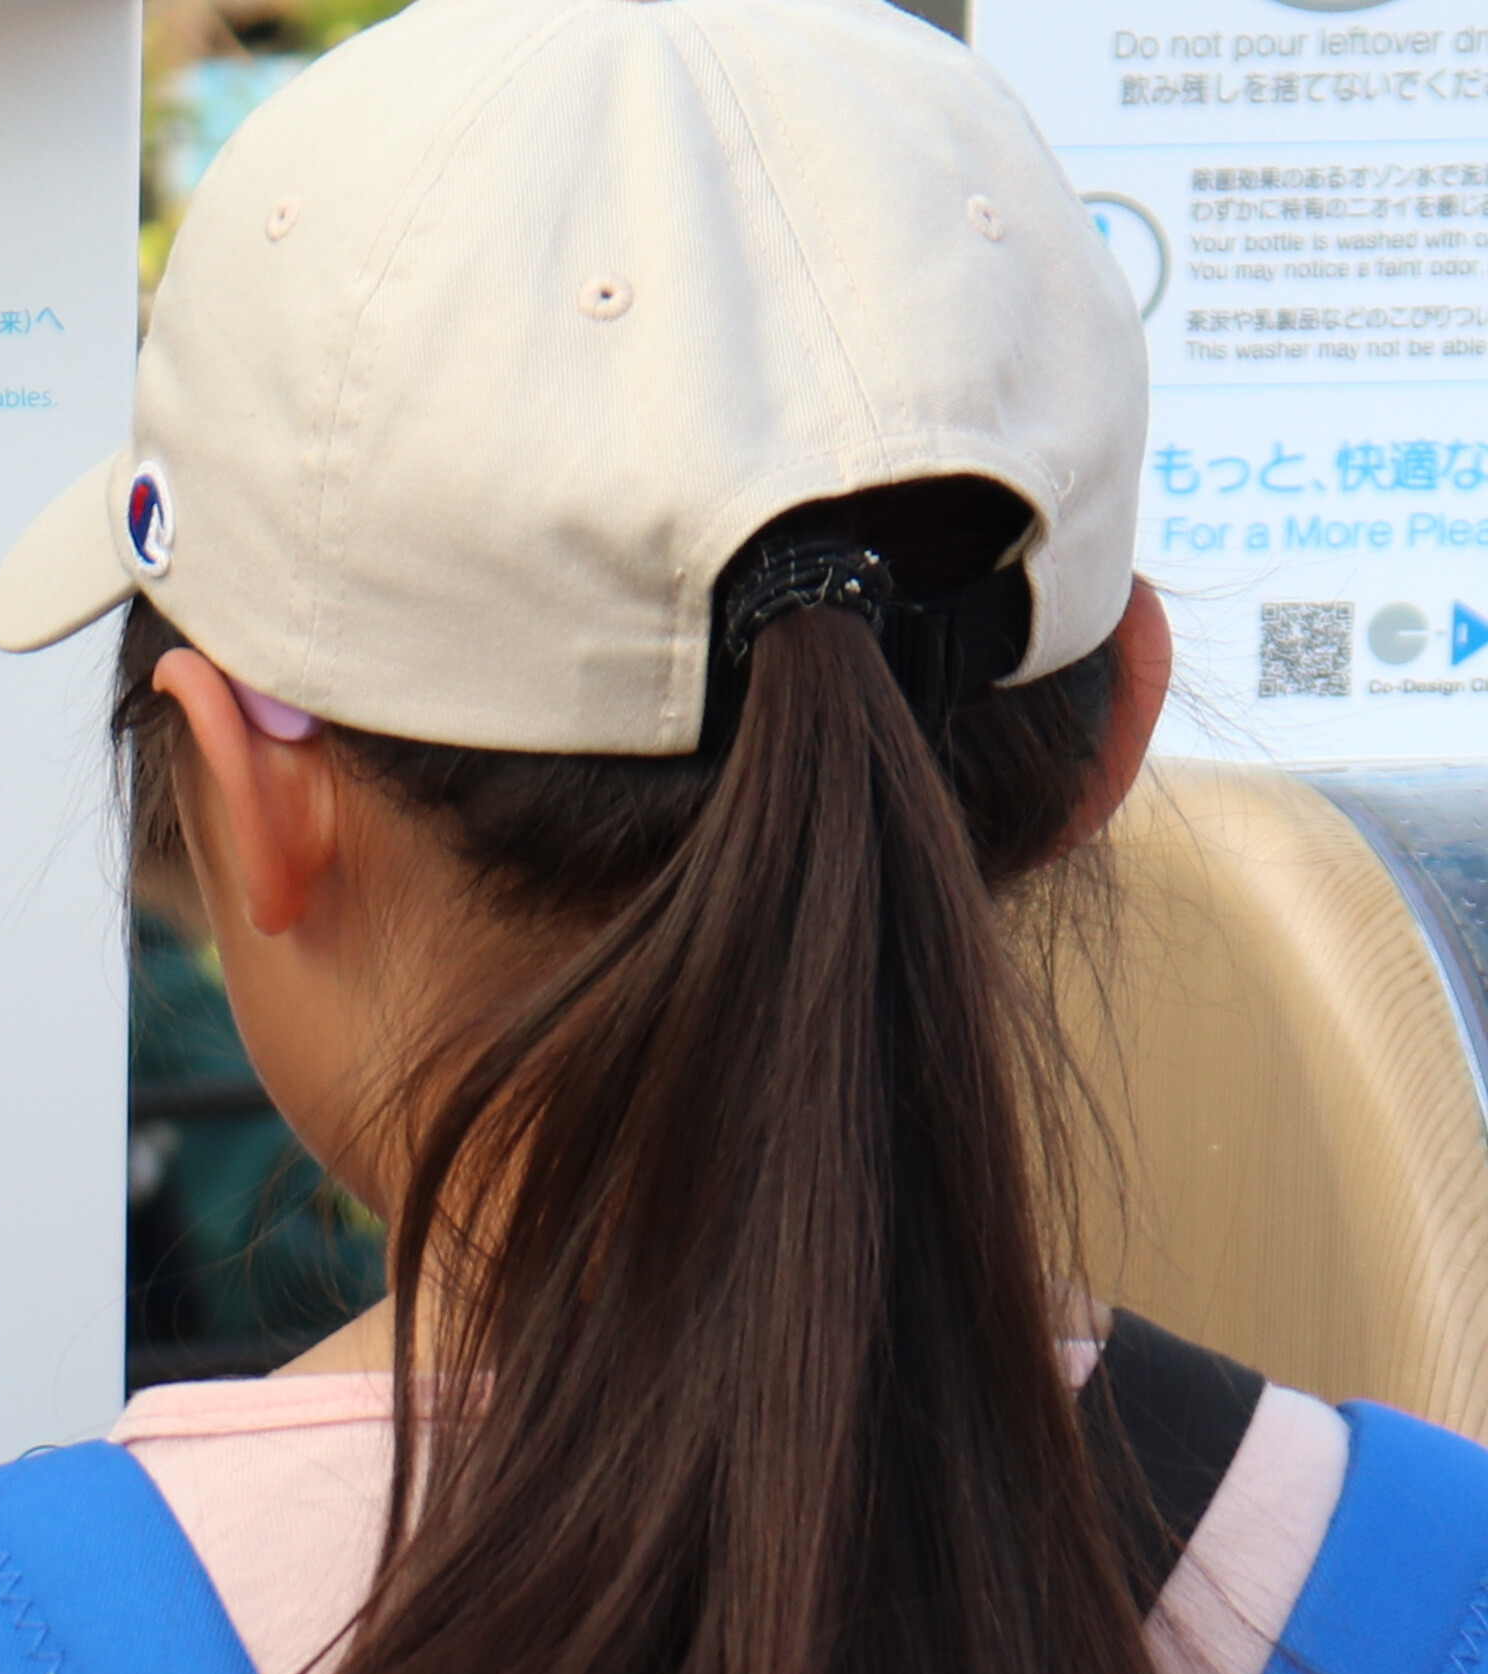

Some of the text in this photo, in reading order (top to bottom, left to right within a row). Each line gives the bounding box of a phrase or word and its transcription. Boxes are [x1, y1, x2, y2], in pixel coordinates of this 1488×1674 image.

[1115, 30, 1159, 58] Do
[1171, 30, 1221, 57] not
[1235, 33, 1308, 61] pour
[1321, 27, 1444, 55] leftover
[1189, 233, 1236, 252] Your
[1244, 232, 1305, 251] bottle
[1313, 231, 1329, 250] is
[1337, 231, 1418, 250] washed
[1426, 229, 1467, 248] with
[1189, 262, 1228, 280] You
[1235, 263, 1276, 281] may
[1284, 259, 1350, 278] notice
[1358, 262, 1370, 277] a
[1377, 257, 1423, 276] faint
[1185, 336, 1487, 360] This washer may not be able
[1165, 516, 1233, 551] For
[1246, 522, 1270, 549] a
[1285, 515, 1393, 549] More
[1369, 678, 1466, 697] Co-Design
